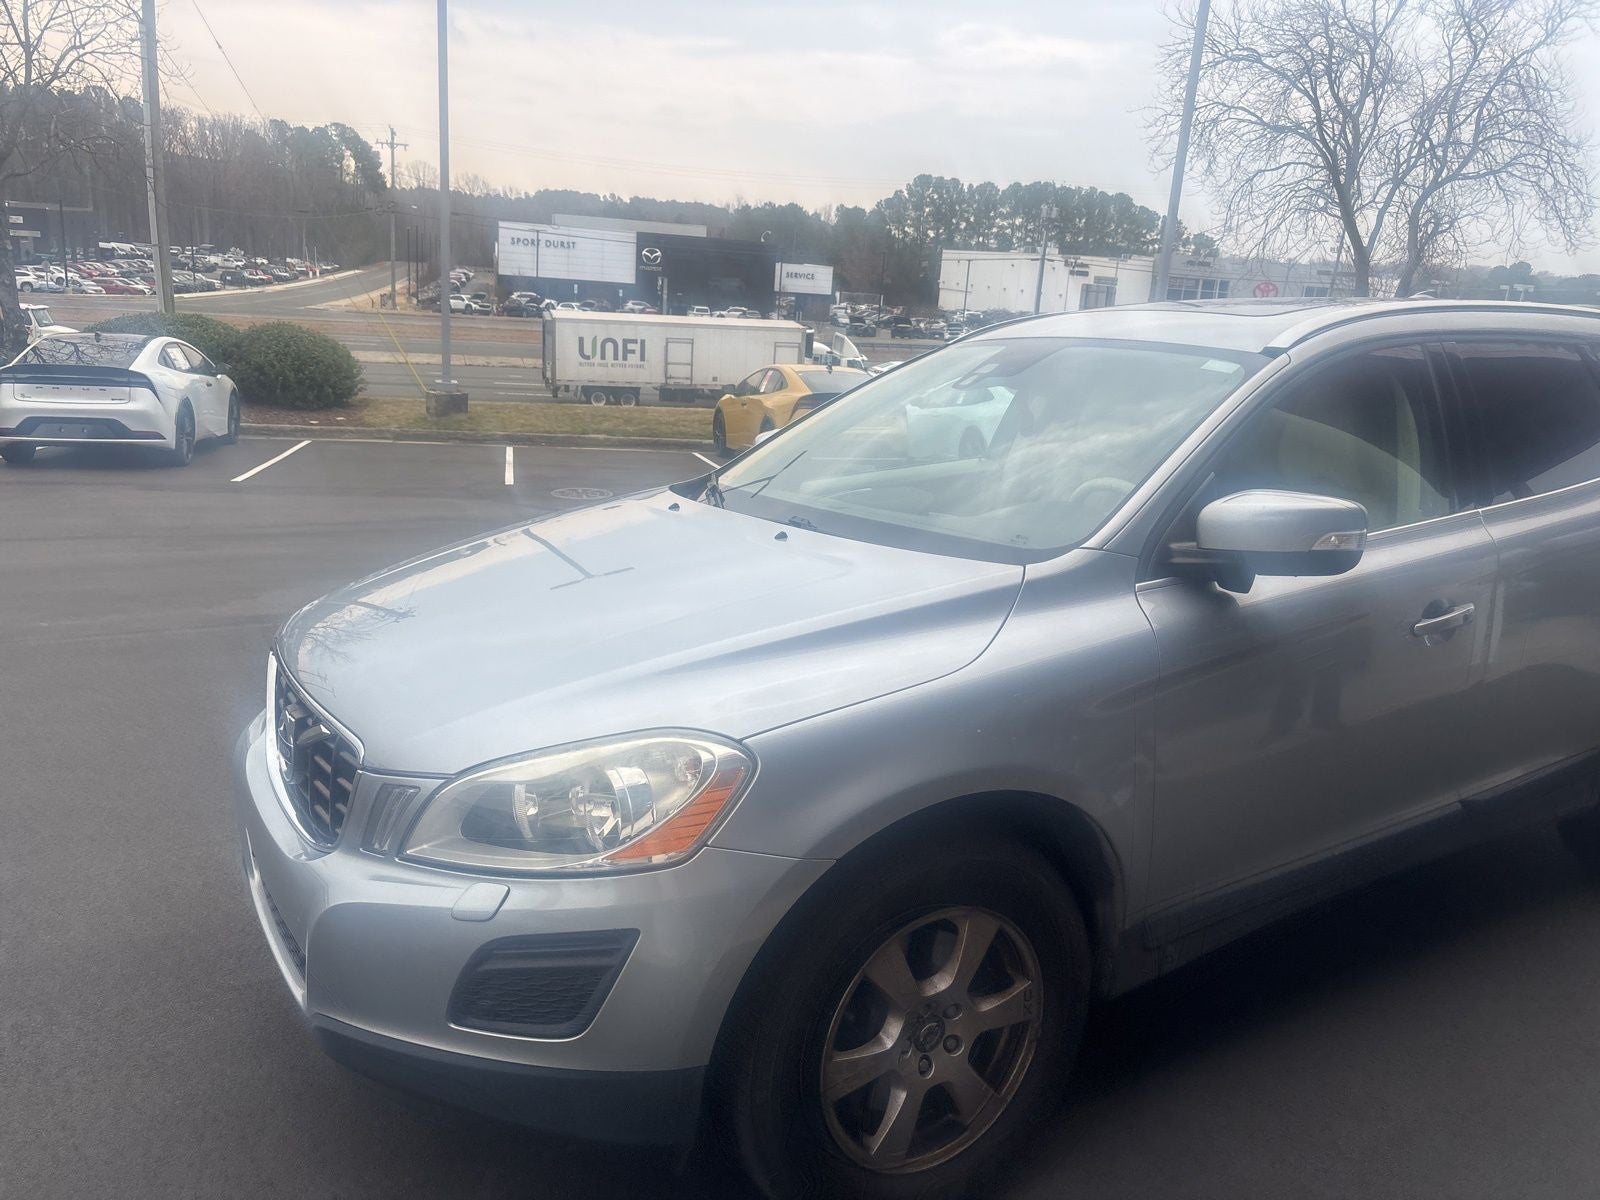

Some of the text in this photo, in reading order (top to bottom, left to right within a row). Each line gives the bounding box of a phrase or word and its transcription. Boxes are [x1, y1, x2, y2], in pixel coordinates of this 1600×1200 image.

[510, 237, 577, 249] SPORT DURST
[785, 271, 816, 280] SERVICE
[578, 335, 646, 362] UNFI
